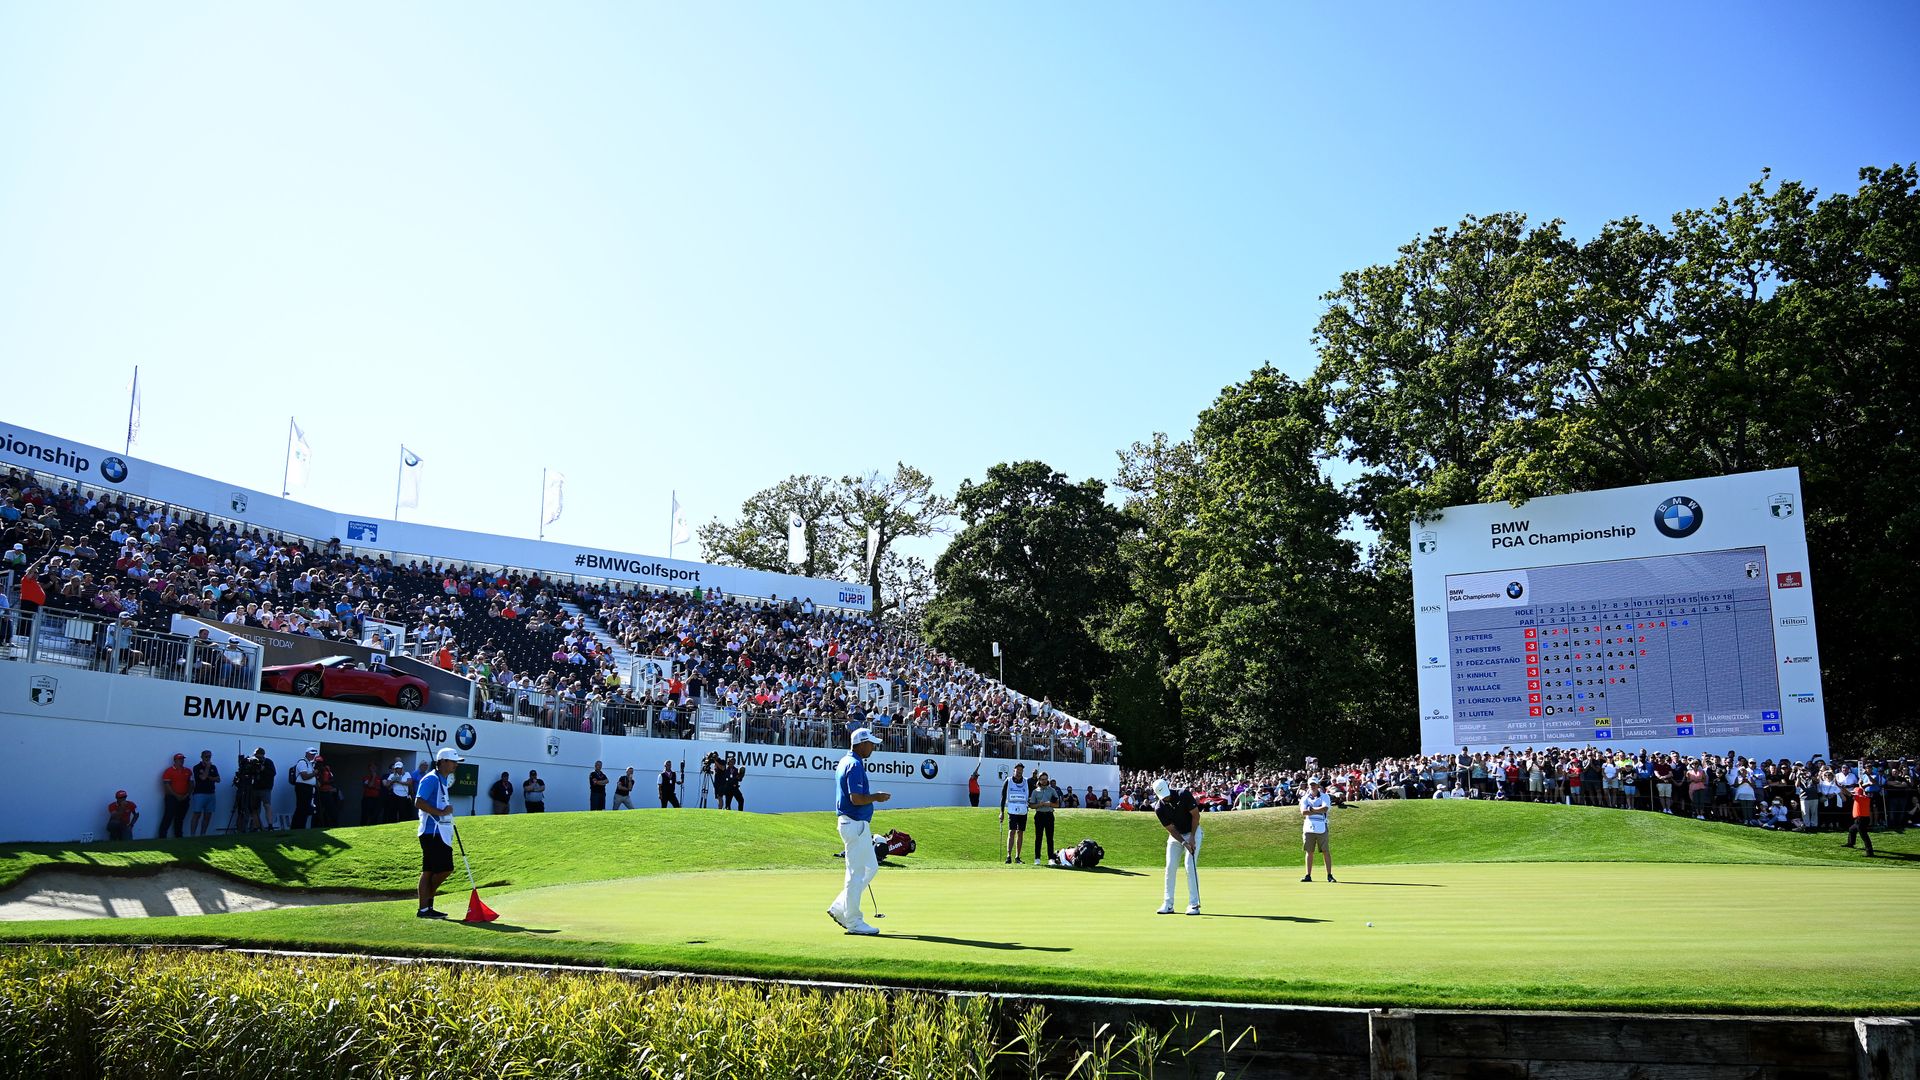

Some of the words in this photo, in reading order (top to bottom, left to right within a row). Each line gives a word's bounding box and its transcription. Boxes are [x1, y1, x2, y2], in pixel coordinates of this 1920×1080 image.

[1658, 498, 1698, 512] BMW
[1491, 520, 1529, 535] BMW
[1492, 537, 1524, 549] PGA
[1528, 525, 1636, 545] Championship
[574, 554, 700, 581] #BMWGolfsport
[839, 592, 865, 605] DUBAI
[1462, 593, 1501, 601] Championship
[268, 638, 294, 648] TODAY
[1468, 696, 1522, 704] LORENZO-VERA
[183, 695, 250, 722] BMW
[256, 703, 305, 728] PGA
[312, 710, 448, 746] Championship
[772, 753, 807, 769] PGA
[811, 756, 914, 777] Chaionship
